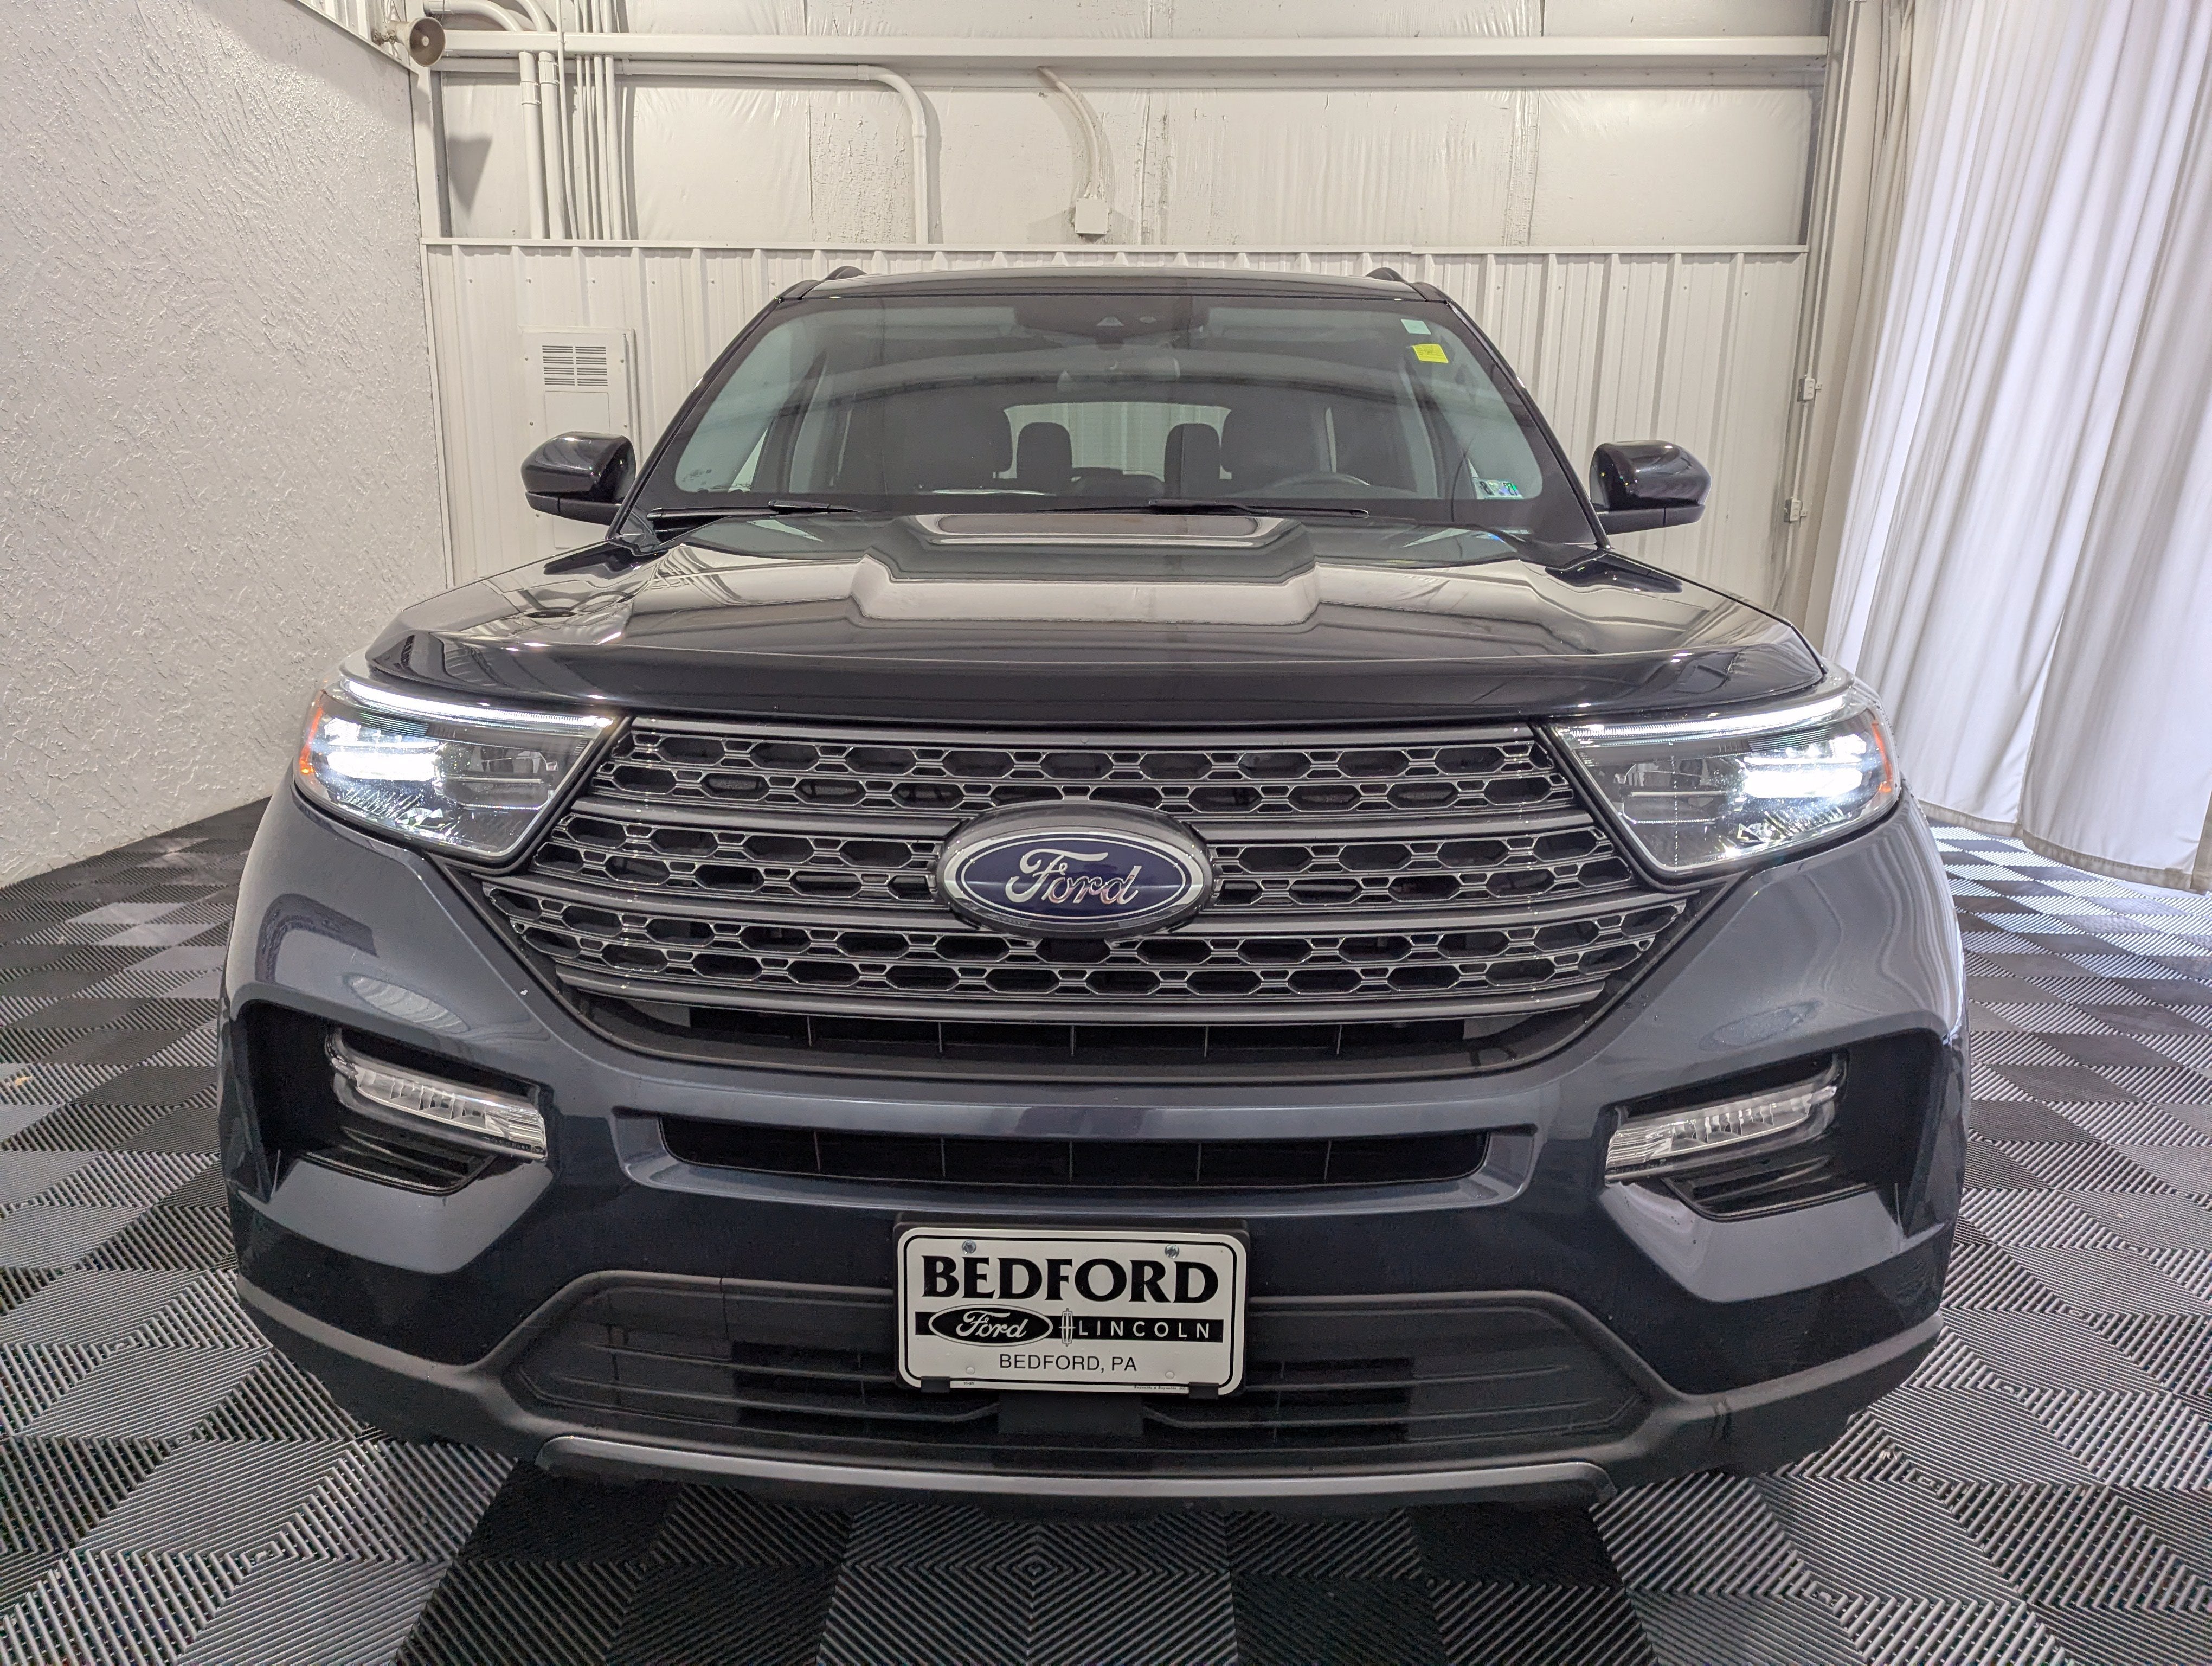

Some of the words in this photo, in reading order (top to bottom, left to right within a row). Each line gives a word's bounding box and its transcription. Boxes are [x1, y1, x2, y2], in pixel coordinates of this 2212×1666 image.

[1005, 849, 1142, 904] Ford
[922, 1255, 1218, 1303] BEDFORD
[956, 1310, 1028, 1338] Ford
[1079, 1320, 1209, 1338] LINCOLN
[1000, 1354, 1104, 1373] BEDFORD,
[1111, 1357, 1137, 1372] PA
